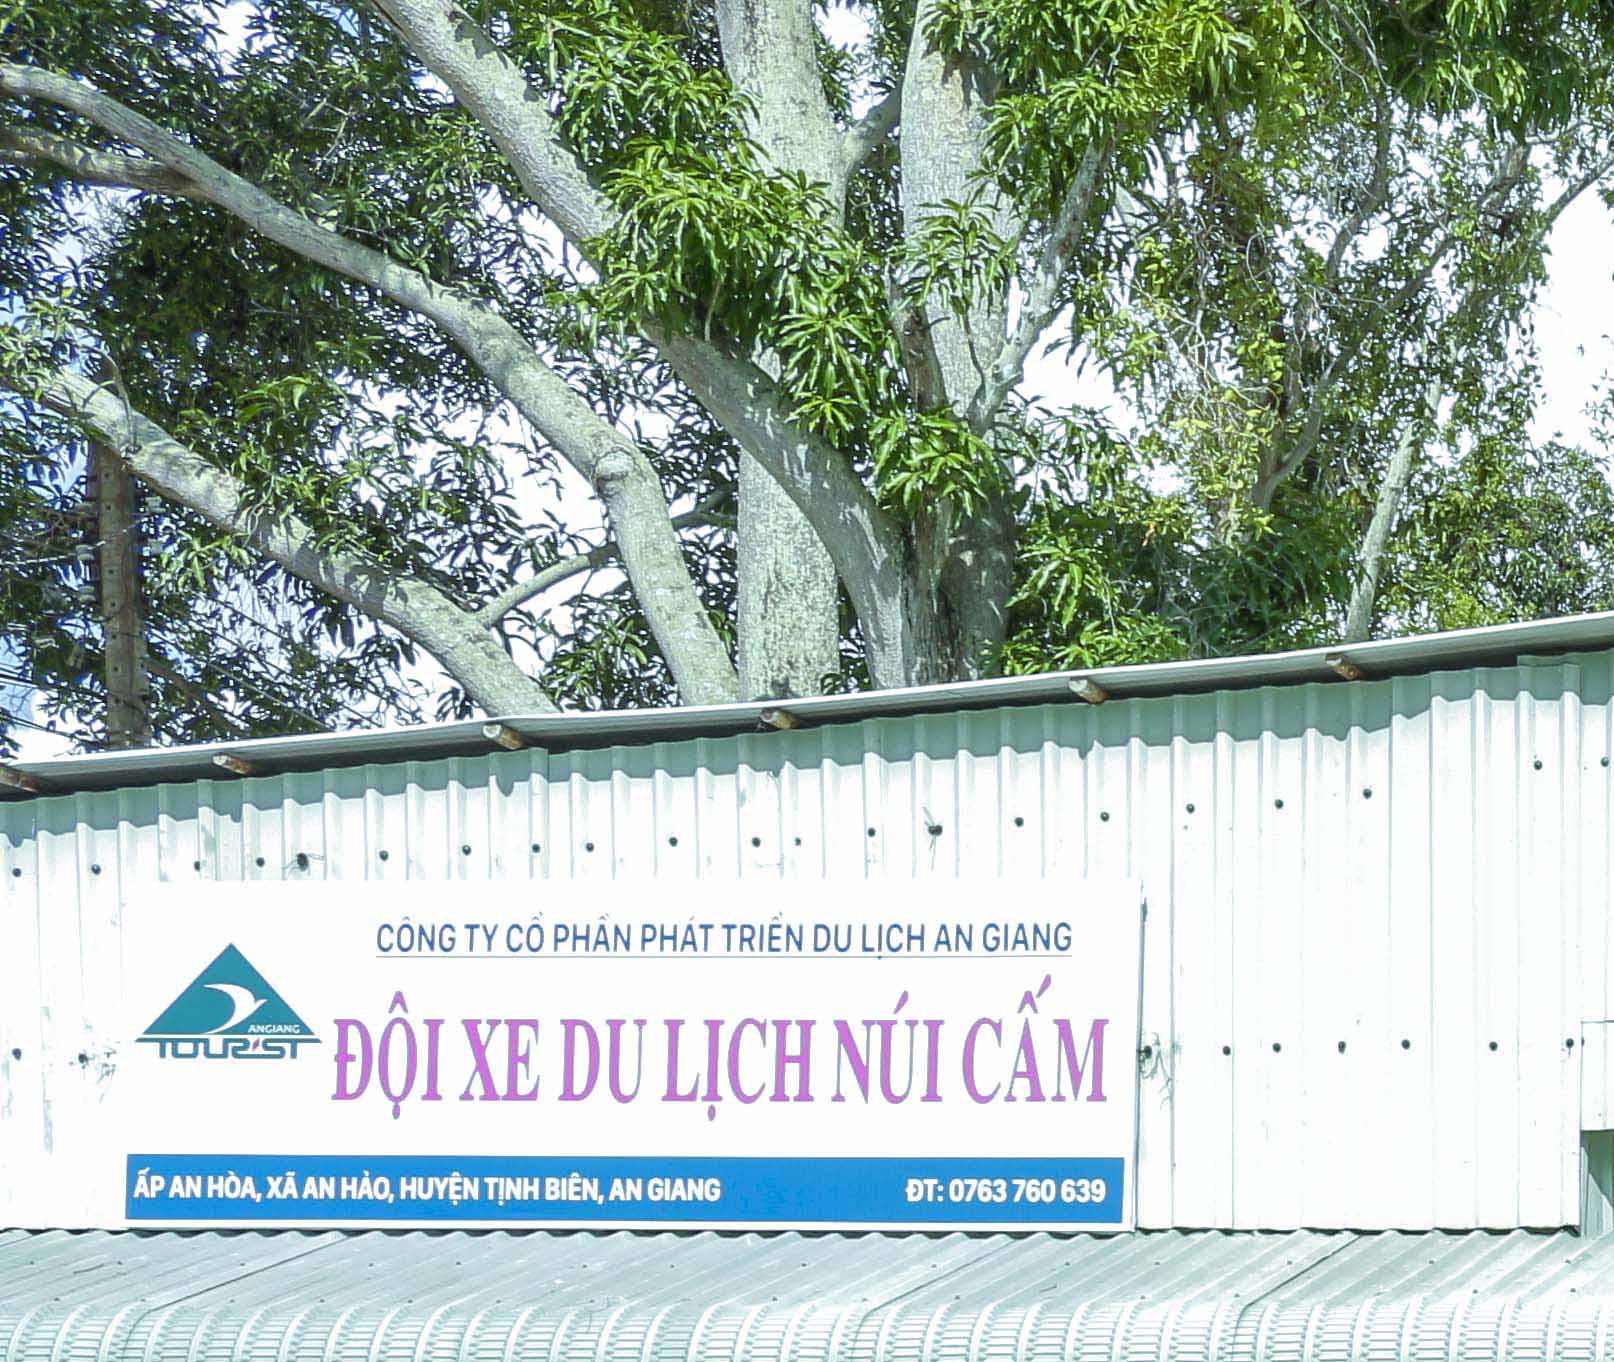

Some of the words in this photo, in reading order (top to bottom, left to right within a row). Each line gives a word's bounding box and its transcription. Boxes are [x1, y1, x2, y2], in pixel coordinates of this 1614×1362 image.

[377, 916, 456, 953] CÔNG
[464, 924, 498, 953] TY
[506, 912, 545, 953] CỔ
[554, 913, 631, 953] PHẦN
[641, 916, 714, 953] PHÁT
[722, 911, 803, 953] TRIỂN
[813, 923, 851, 953] DU
[862, 923, 925, 960] LỊCH
[934, 923, 973, 952] AN
[982, 922, 1072, 952] GIANG
[248, 1024, 300, 1034] ANGIANG
[331, 990, 445, 1120] ĐỘI
[459, 1018, 541, 1102] XE
[558, 1018, 647, 1104] DU
[661, 1018, 816, 1122] LỊCH
[831, 990, 945, 1104] NÚI
[962, 973, 1109, 1104] CẤM
[133, 1167, 165, 1198] ẤP
[168, 1175, 202, 1199] AN
[207, 1170, 263, 1203] HÒA,
[266, 1171, 298, 1199] XÃ
[302, 1176, 336, 1199] AN
[400, 1171, 479, 1206] HUYỆN
[484, 1177, 540, 1206] TỊNH
[544, 1172, 604, 1205] BIÊN,
[608, 1178, 642, 1201] AN
[647, 1177, 721, 1202] GIANG
[906, 1178, 944, 1202] ĐT:
[949, 1178, 1008, 1203] 0763
[1011, 1178, 1057, 1203] 760
[1060, 1178, 1106, 1203] 639
